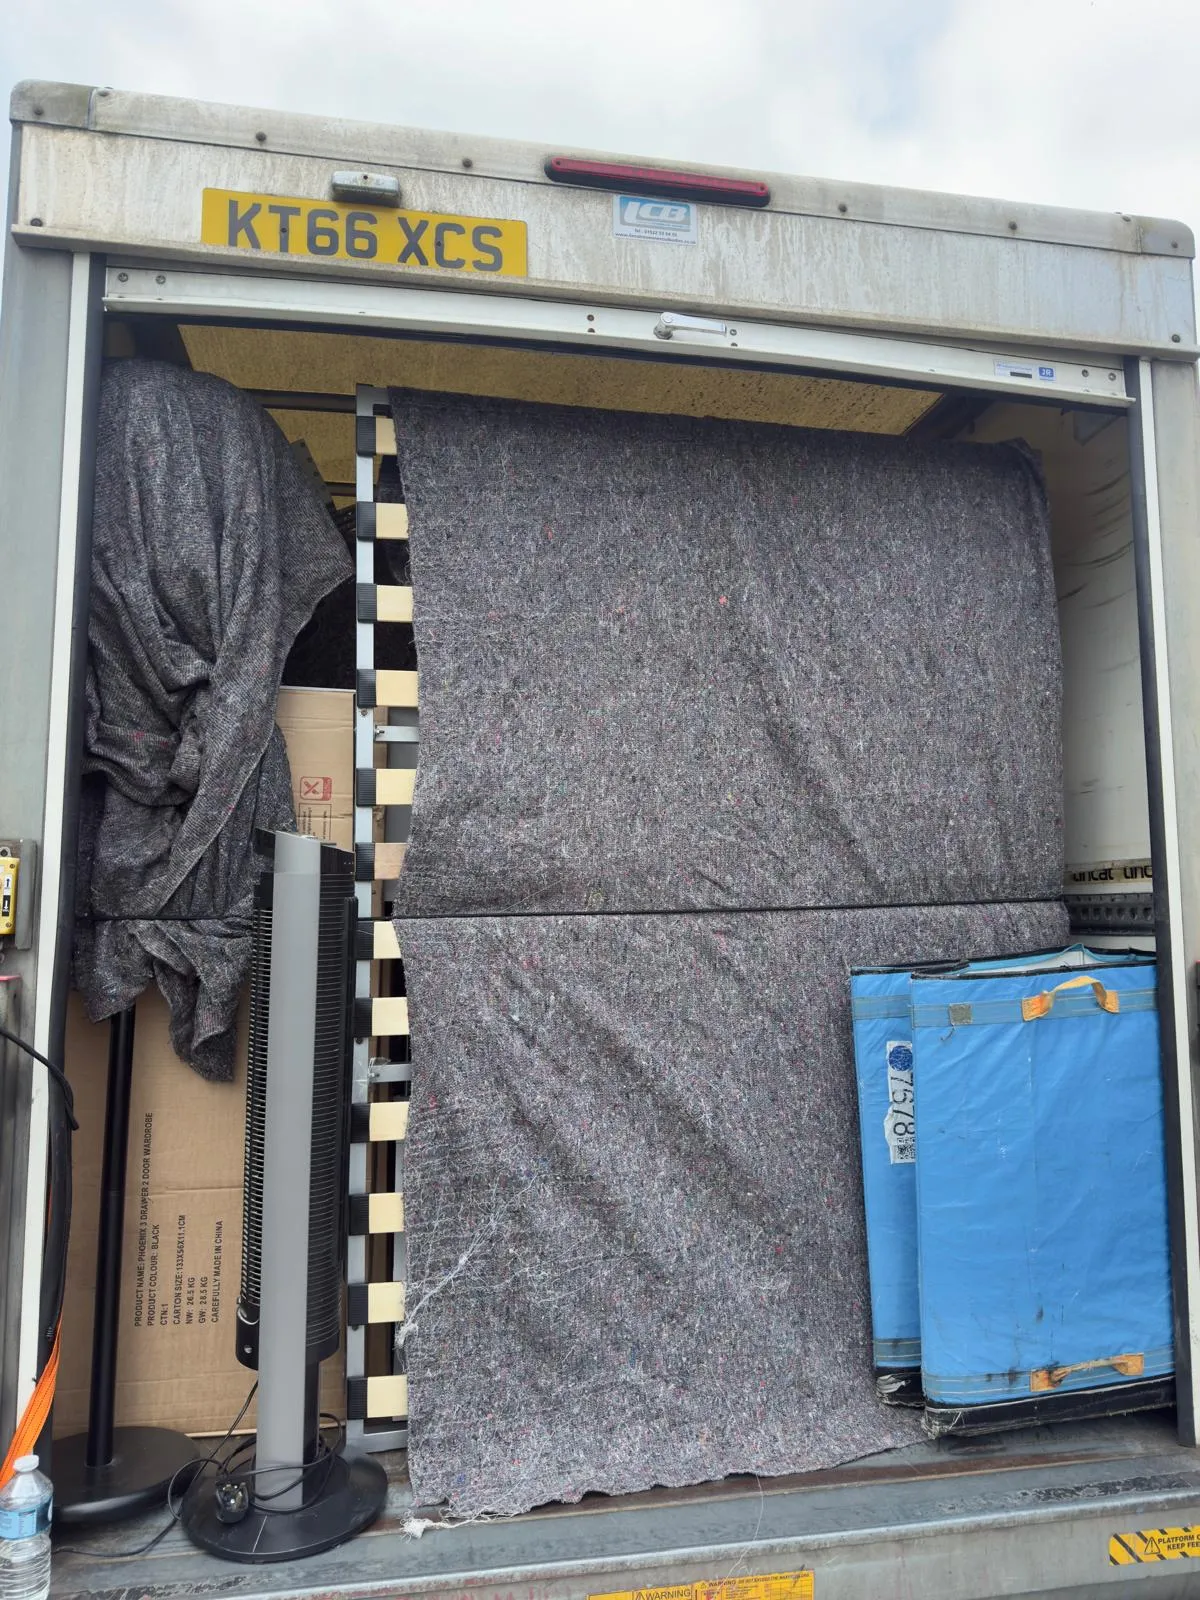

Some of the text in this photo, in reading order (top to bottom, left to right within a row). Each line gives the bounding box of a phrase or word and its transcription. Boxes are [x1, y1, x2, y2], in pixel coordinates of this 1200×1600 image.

[624, 201, 688, 223] LCB
[228, 199, 503, 272] KT66 XCS
[143, 1112, 153, 1156] WARDROBE
[142, 1158, 150, 1179] DOOR
[140, 1188, 149, 1220] DRAWER
[138, 1228, 147, 1262] PHOENIX
[136, 1263, 145, 1289] NAME:
[147, 1224, 160, 1326] PRODUCT COLOUR: BLACK
[211, 1220, 223, 1323] CAREFULLY MADE IN CHINA
[134, 1289, 143, 1327] PRODUCT
[160, 1303, 168, 1326] CTN:1
[173, 1293, 182, 1325] CARTON
[185, 1277, 196, 1324] NW: 26.5 KG
[198, 1276, 208, 1324] GW: 28.5 KG
[1157, 1534, 1194, 1545] PLATFORM
[1167, 1543, 1186, 1551] KEEP
[645, 1588, 691, 1600] WARNING
